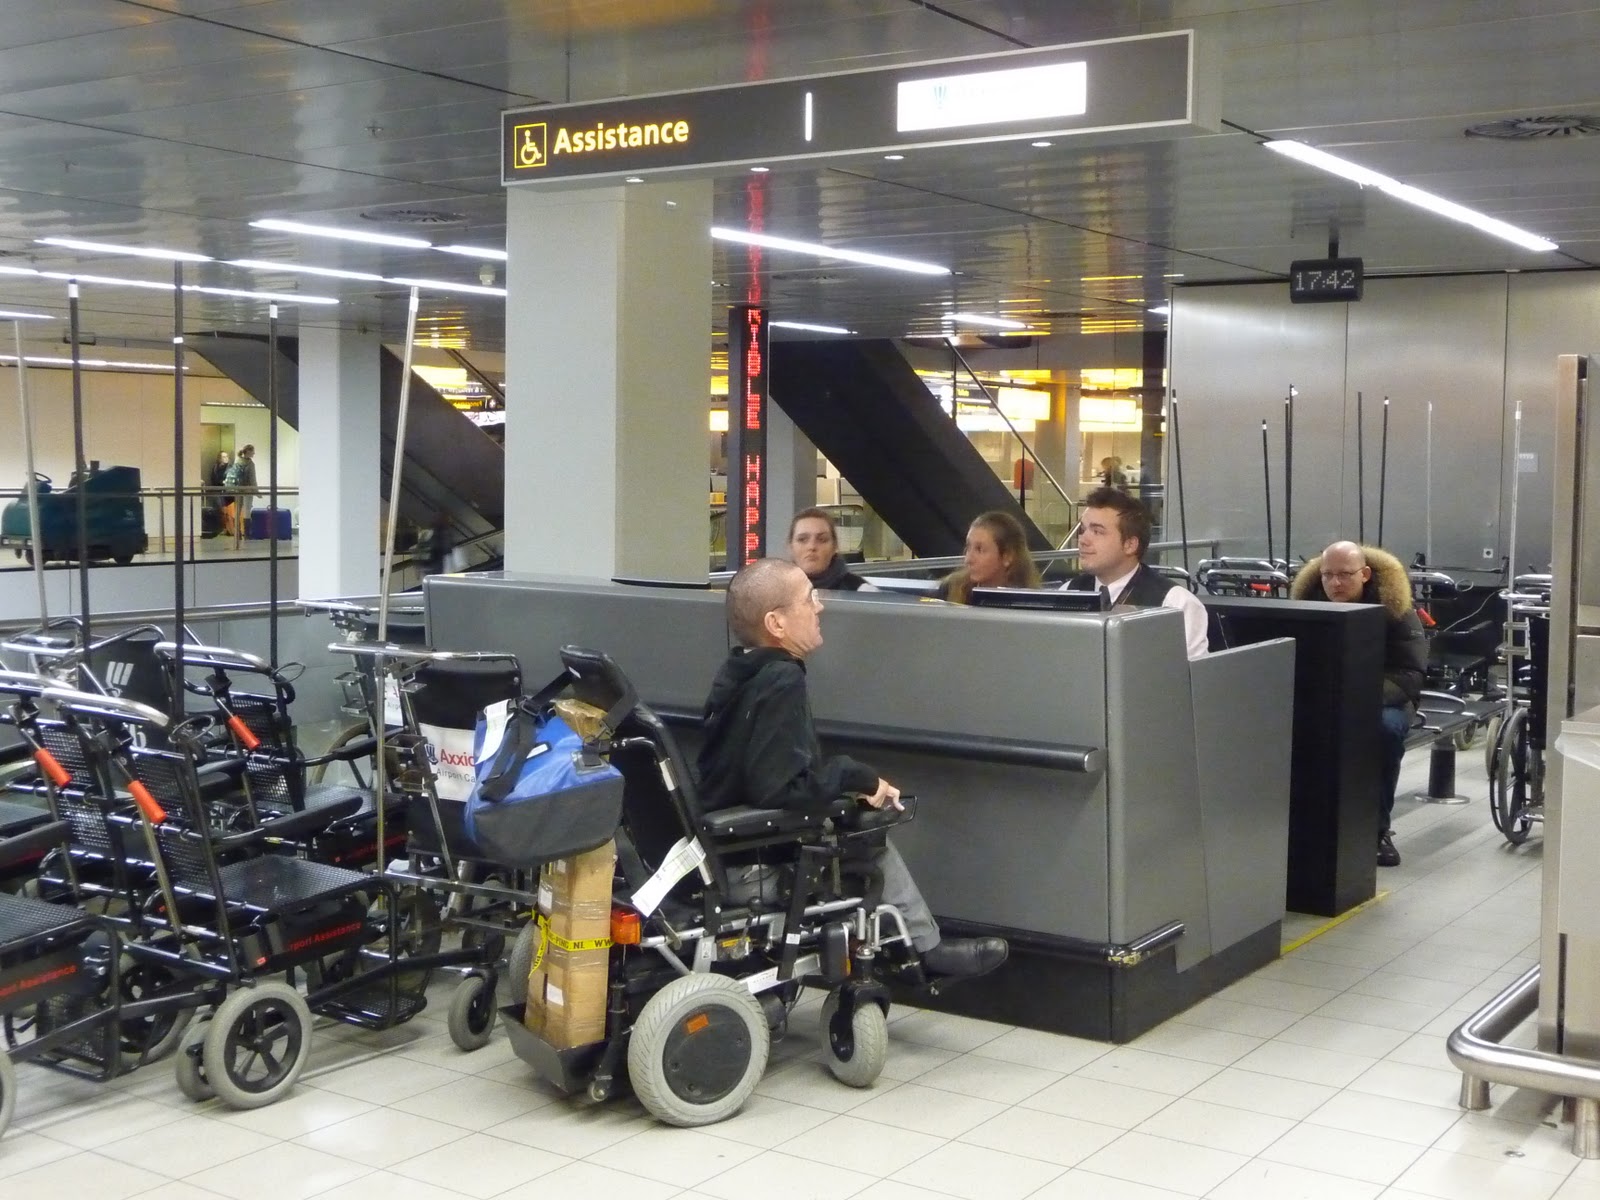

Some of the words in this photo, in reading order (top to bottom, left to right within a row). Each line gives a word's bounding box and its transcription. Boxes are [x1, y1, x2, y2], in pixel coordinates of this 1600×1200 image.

[553, 120, 690, 155] Assistance
[1296, 269, 1355, 291] 17:42
[745, 454, 760, 566] HAPP
[314, 921, 362, 943] Assistance
